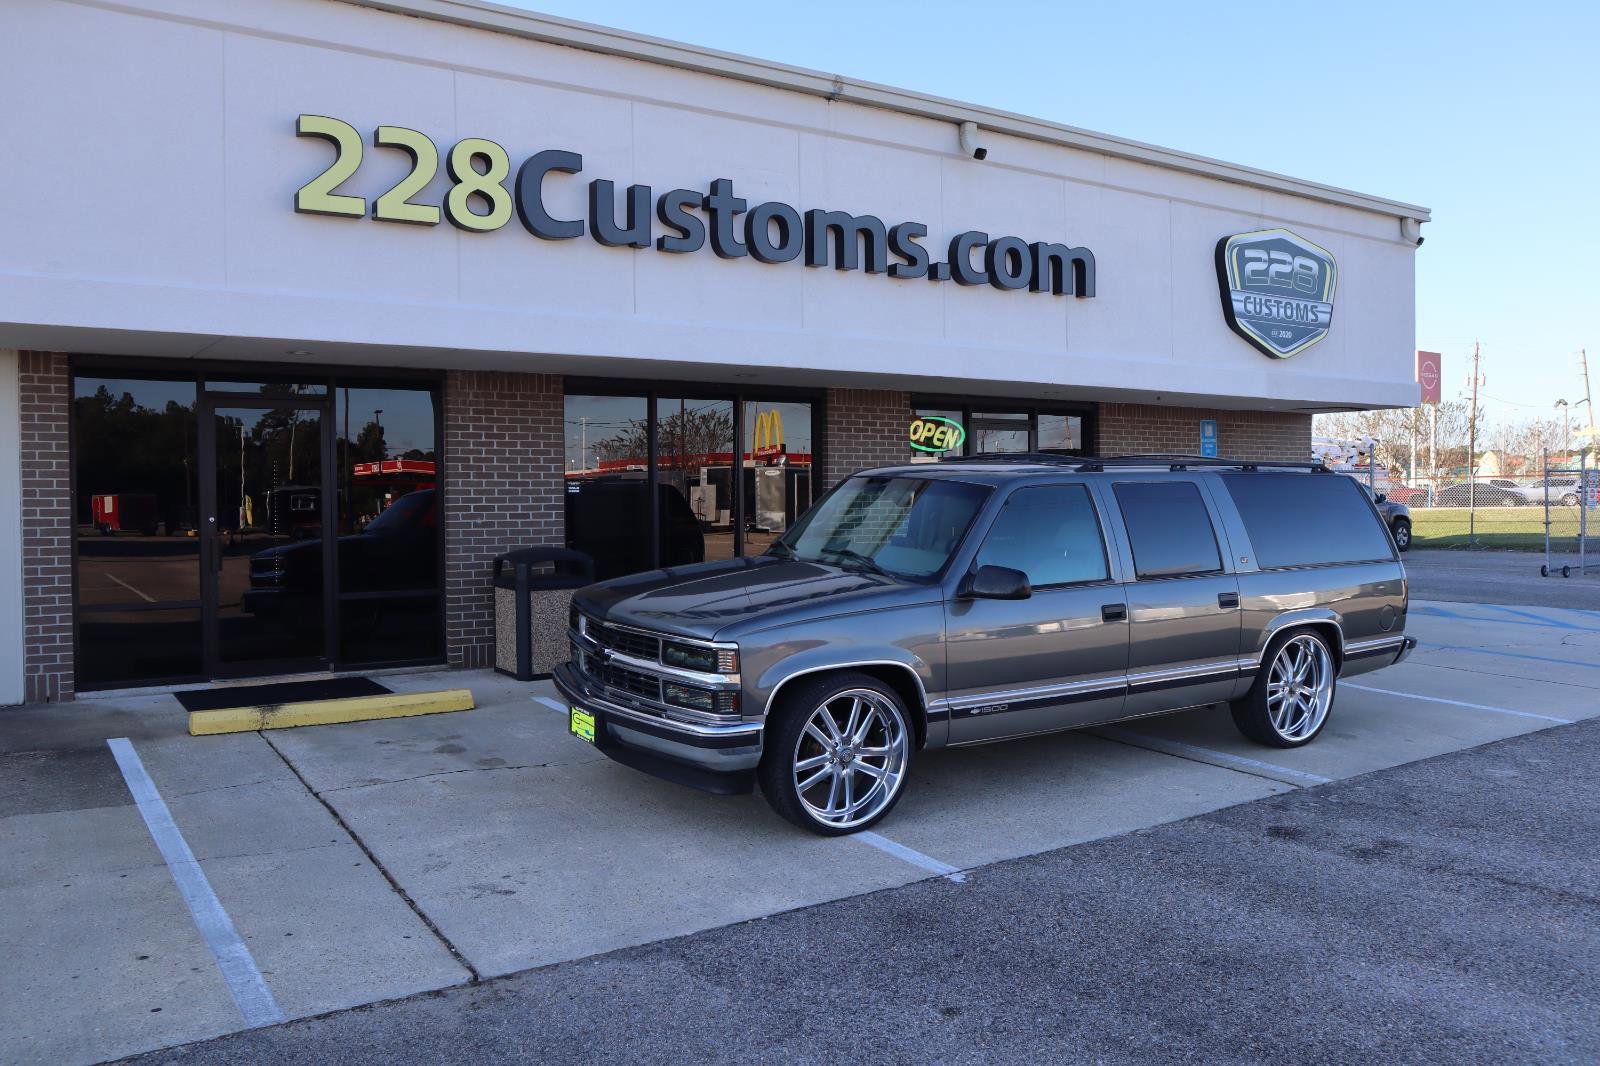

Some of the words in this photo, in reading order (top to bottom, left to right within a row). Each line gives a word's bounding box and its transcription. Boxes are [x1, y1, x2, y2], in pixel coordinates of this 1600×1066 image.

[294, 113, 1096, 298] 228Customs.com
[1244, 249, 1319, 294] 228
[1243, 296, 1319, 323] CUSTOMS
[910, 420, 960, 449] OPEN
[981, 704, 1009, 713] 1500
